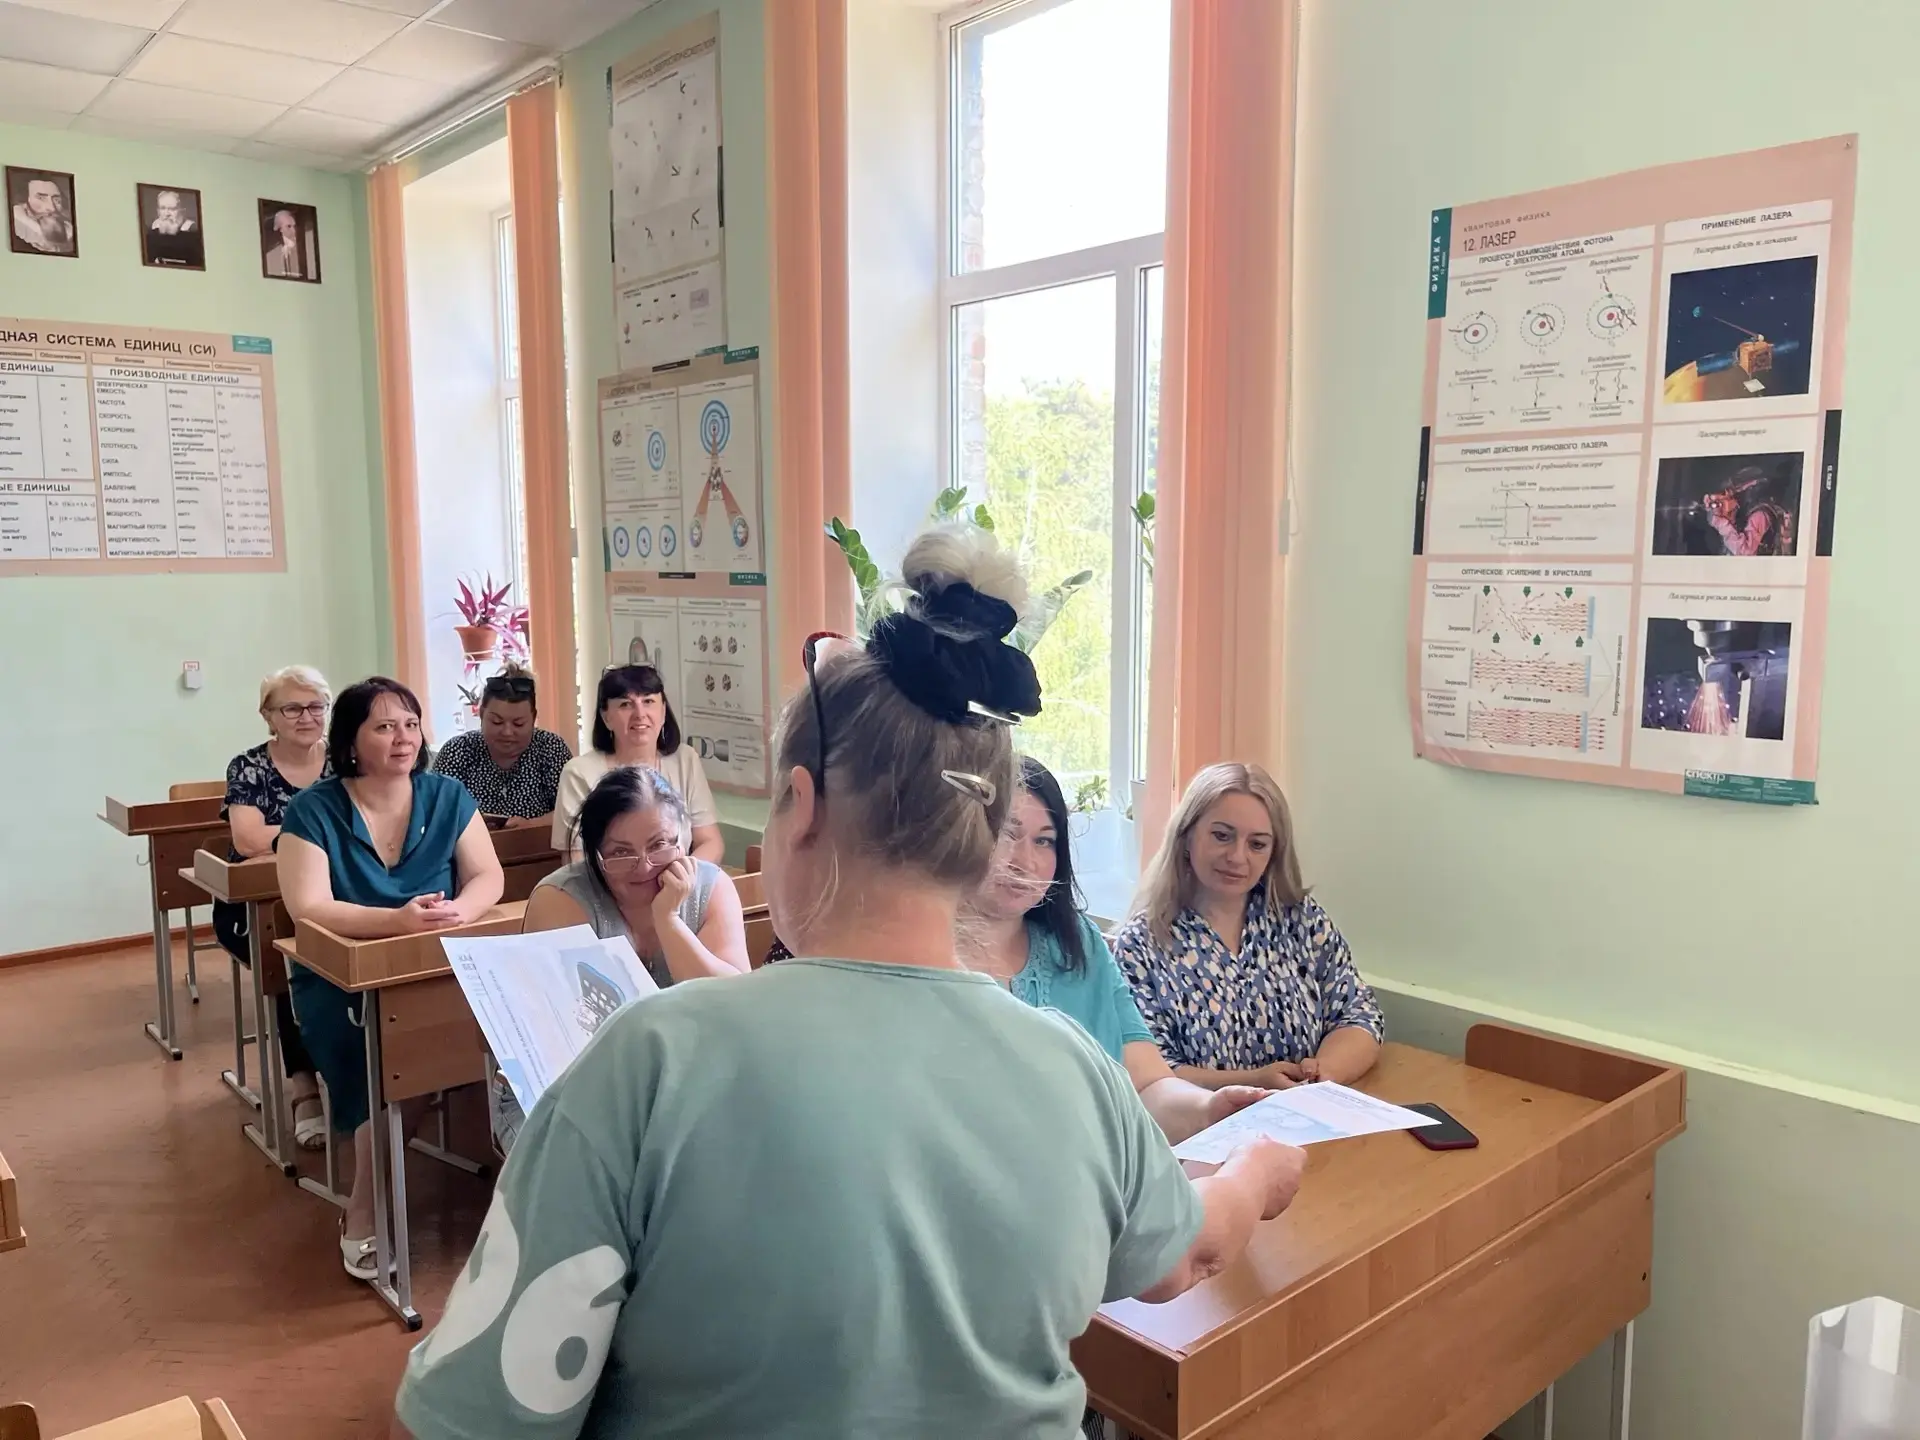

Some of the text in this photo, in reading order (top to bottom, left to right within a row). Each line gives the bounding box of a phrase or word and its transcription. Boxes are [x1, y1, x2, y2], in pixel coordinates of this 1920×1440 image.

[1463, 211, 1551, 233] КВАНТОВАЯ ФИЗИКА
[1701, 209, 1794, 231] ПРИМЕНЕНИЕ ЛАЗЕРА
[1479, 230, 1517, 250] ЛАЗЕР
[1478, 251, 1516, 264] ПРОЦЕССЫ
[1583, 235, 1614, 247] ФОТОНА
[1560, 247, 1585, 258] АТОМА
[1431, 235, 1442, 293] ФИЗИКА
[46, 333, 116, 348] СИСТЕМА
[124, 338, 182, 354] ЕДИНИЦ
[188, 344, 217, 357] (СИ)
[0, 362, 54, 373] ЕДИНИЦЫ
[109, 368, 240, 384] ПРОИЗВОДНЫЕ ЕДИНИЦЫ
[1460, 440, 1609, 455] ПРИНЦИП ДЕЙСТВИЯ РУБИНОВОГО ЛАЗЕРА
[16, 483, 71, 493] ЕДИНИЦЫ
[1461, 568, 1503, 577] ОПТИЧЕСКОЕ
[1506, 569, 1541, 577] УСИЛЕНИЕ
[1552, 569, 1593, 577] КРИСТАЛЛЕ
